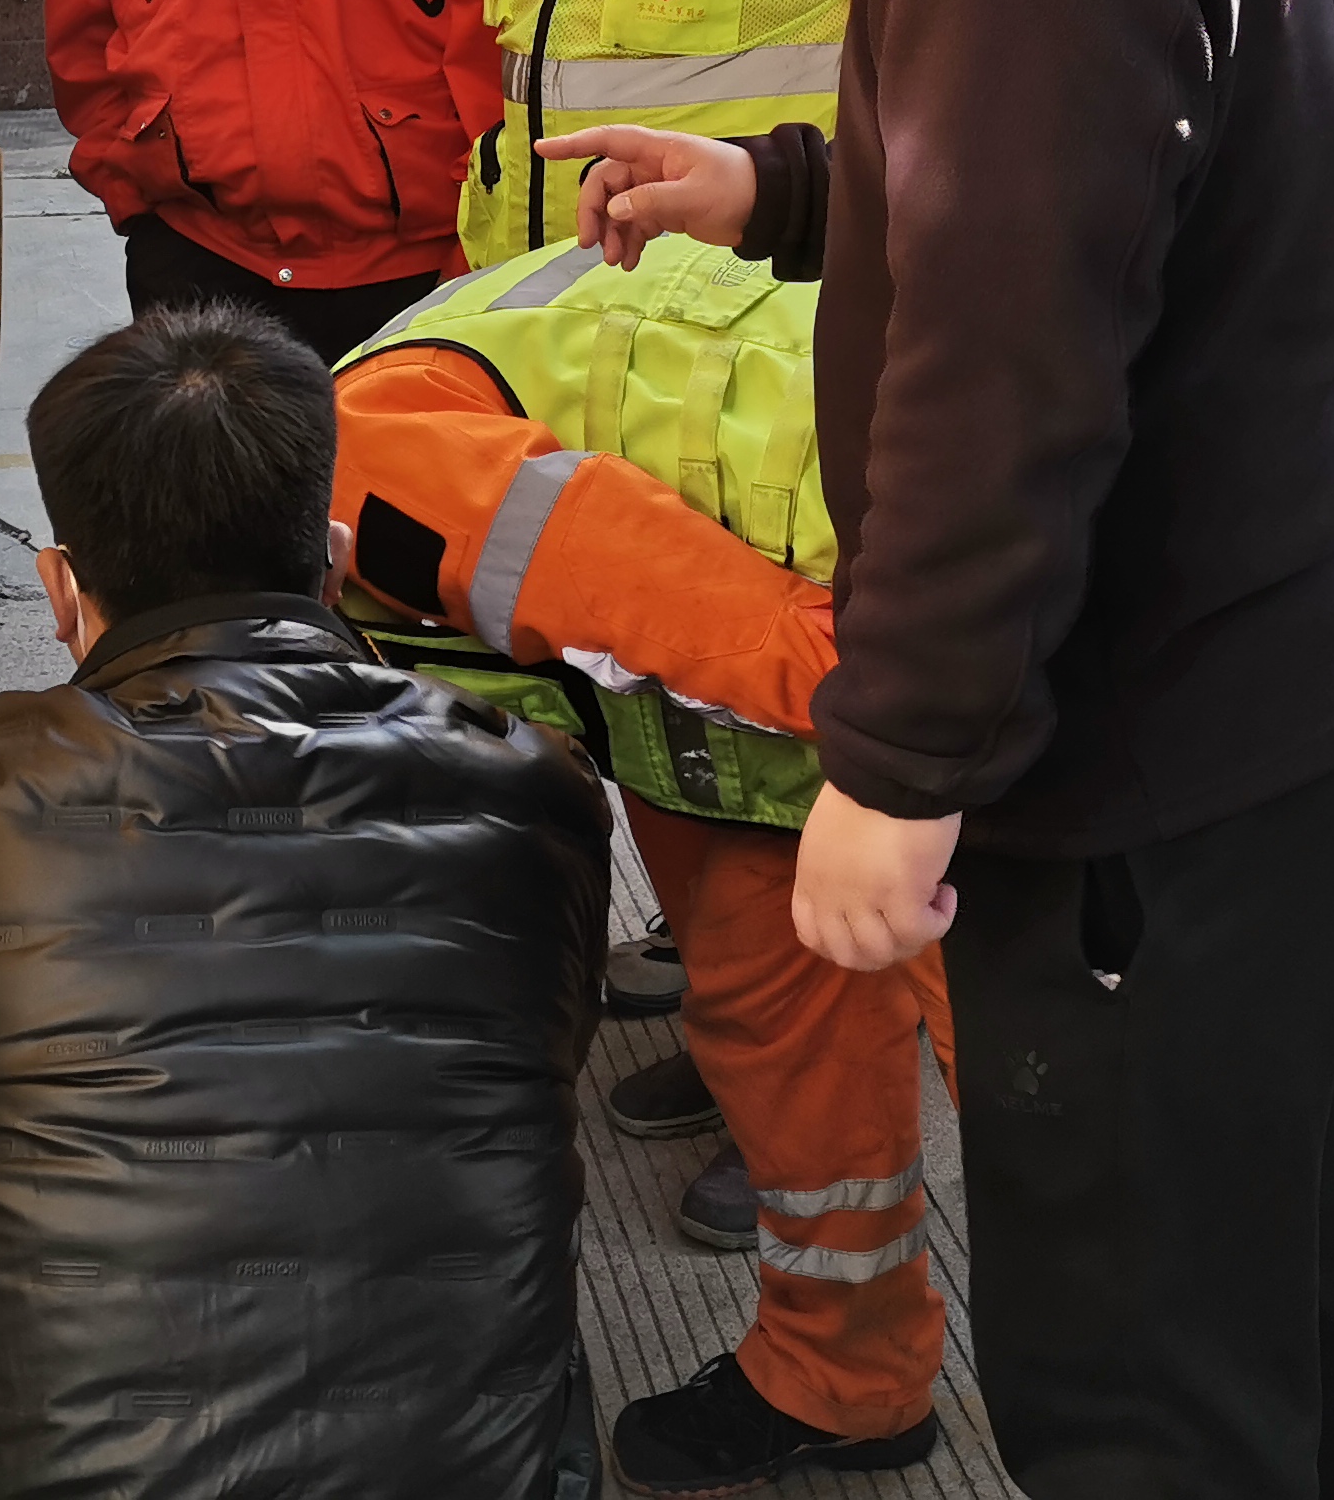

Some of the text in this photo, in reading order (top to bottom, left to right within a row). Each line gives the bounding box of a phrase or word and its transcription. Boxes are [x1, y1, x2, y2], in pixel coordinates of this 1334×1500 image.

[235, 811, 295, 825] FASHION
[330, 912, 388, 927] FASHION
[144, 1140, 207, 1154] FASHION
[235, 1261, 300, 1276] FASHION
